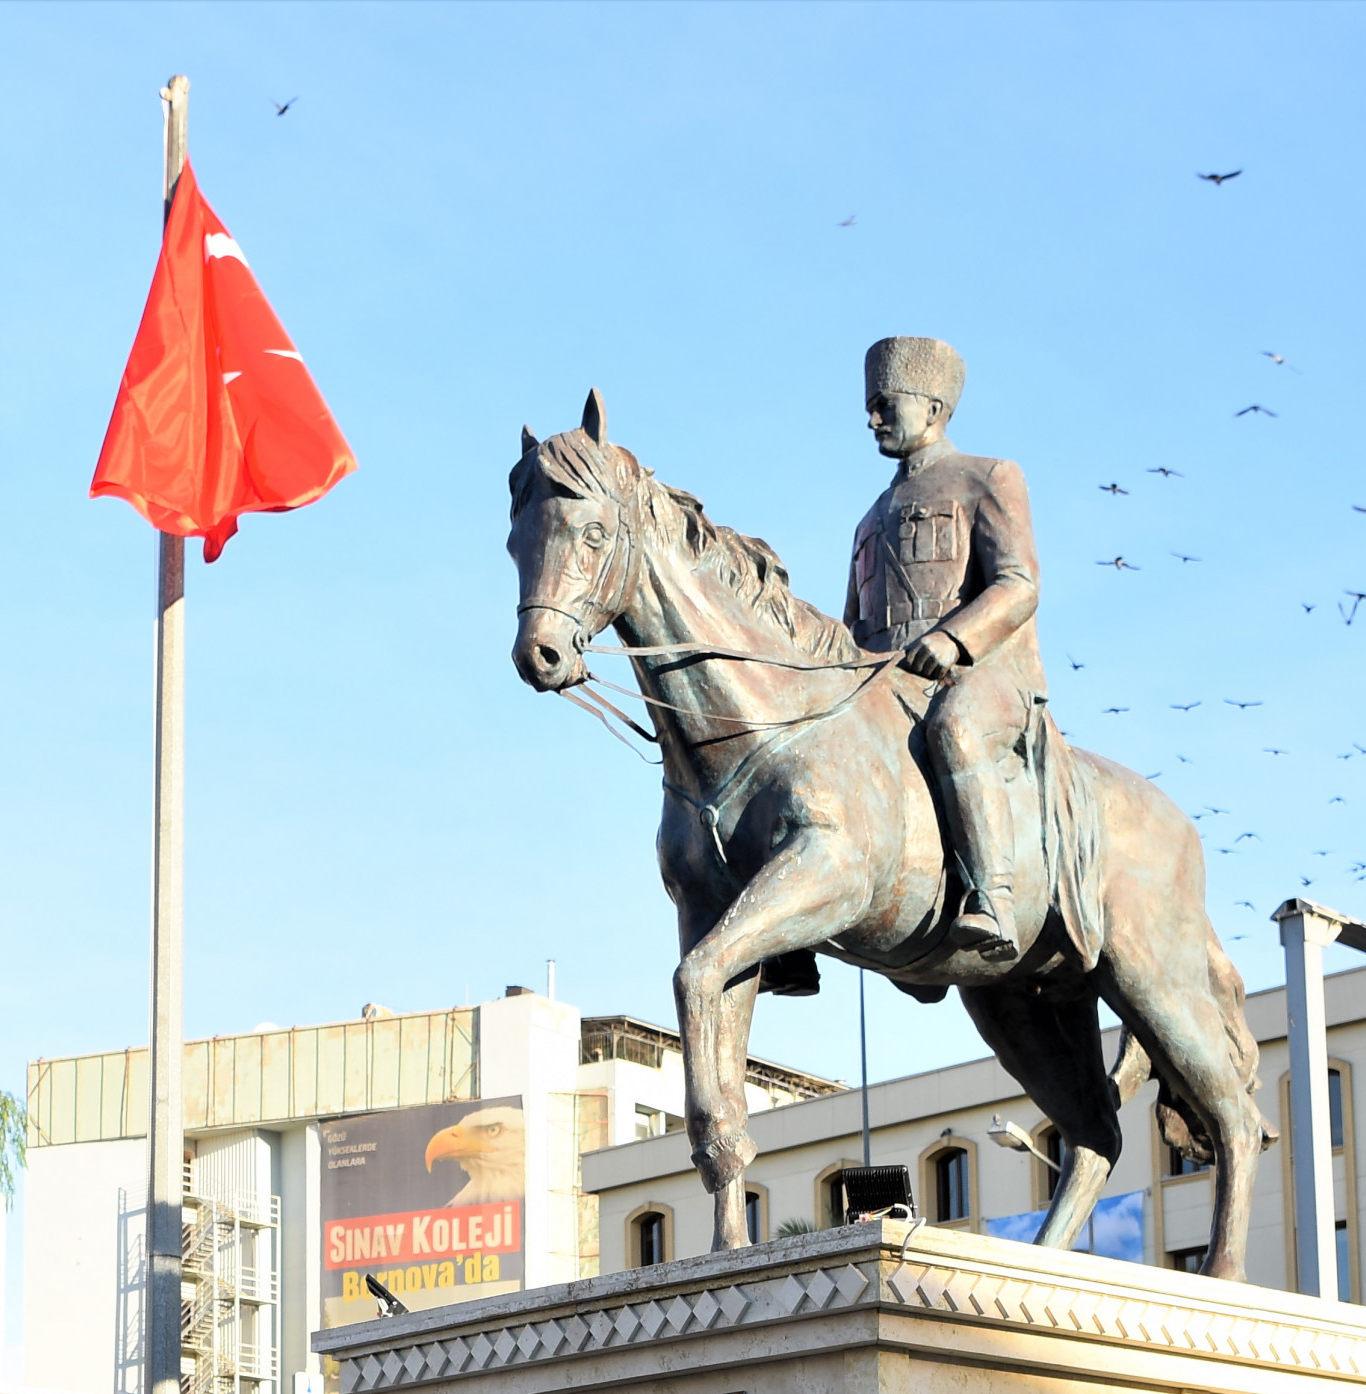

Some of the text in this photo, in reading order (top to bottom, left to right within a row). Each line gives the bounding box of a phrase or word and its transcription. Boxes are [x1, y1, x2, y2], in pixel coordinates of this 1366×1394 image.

[328, 1157, 366, 1170] OLANLARA
[329, 1206, 513, 1264] SINAV KOLEJİ
